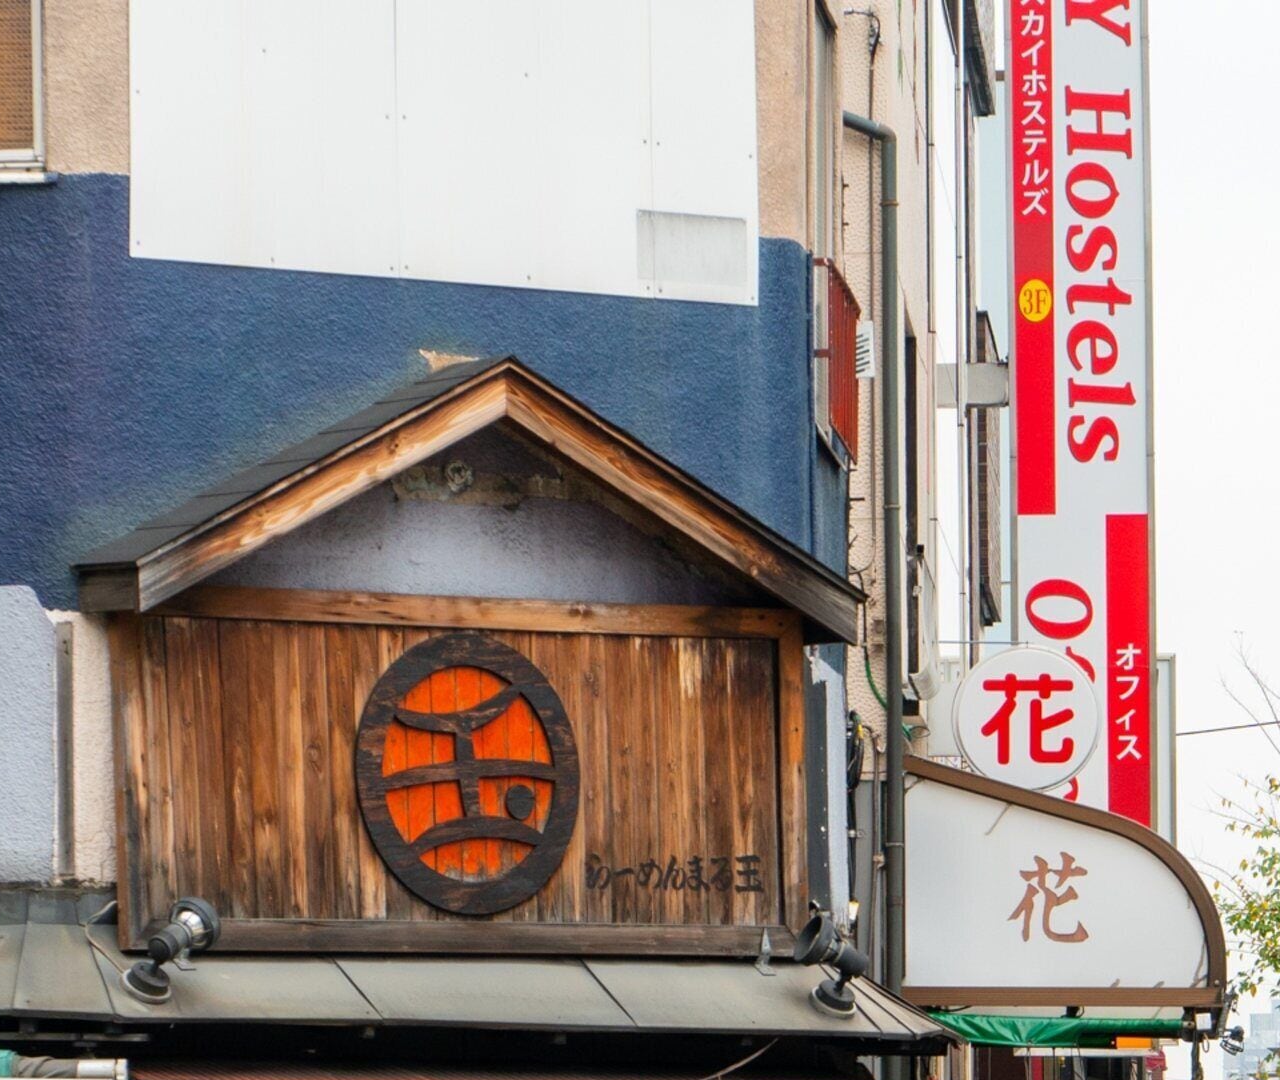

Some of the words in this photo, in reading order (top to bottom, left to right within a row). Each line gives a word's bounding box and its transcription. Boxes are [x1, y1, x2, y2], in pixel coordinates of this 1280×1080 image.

[1020, 0, 1049, 216] カイホステルズ
[1023, 289, 1048, 314] 3F
[1065, 85, 1137, 462] Hostels
[981, 673, 1074, 765] 花
[1114, 643, 1142, 761] オフィス
[1007, 850, 1090, 944] 花
